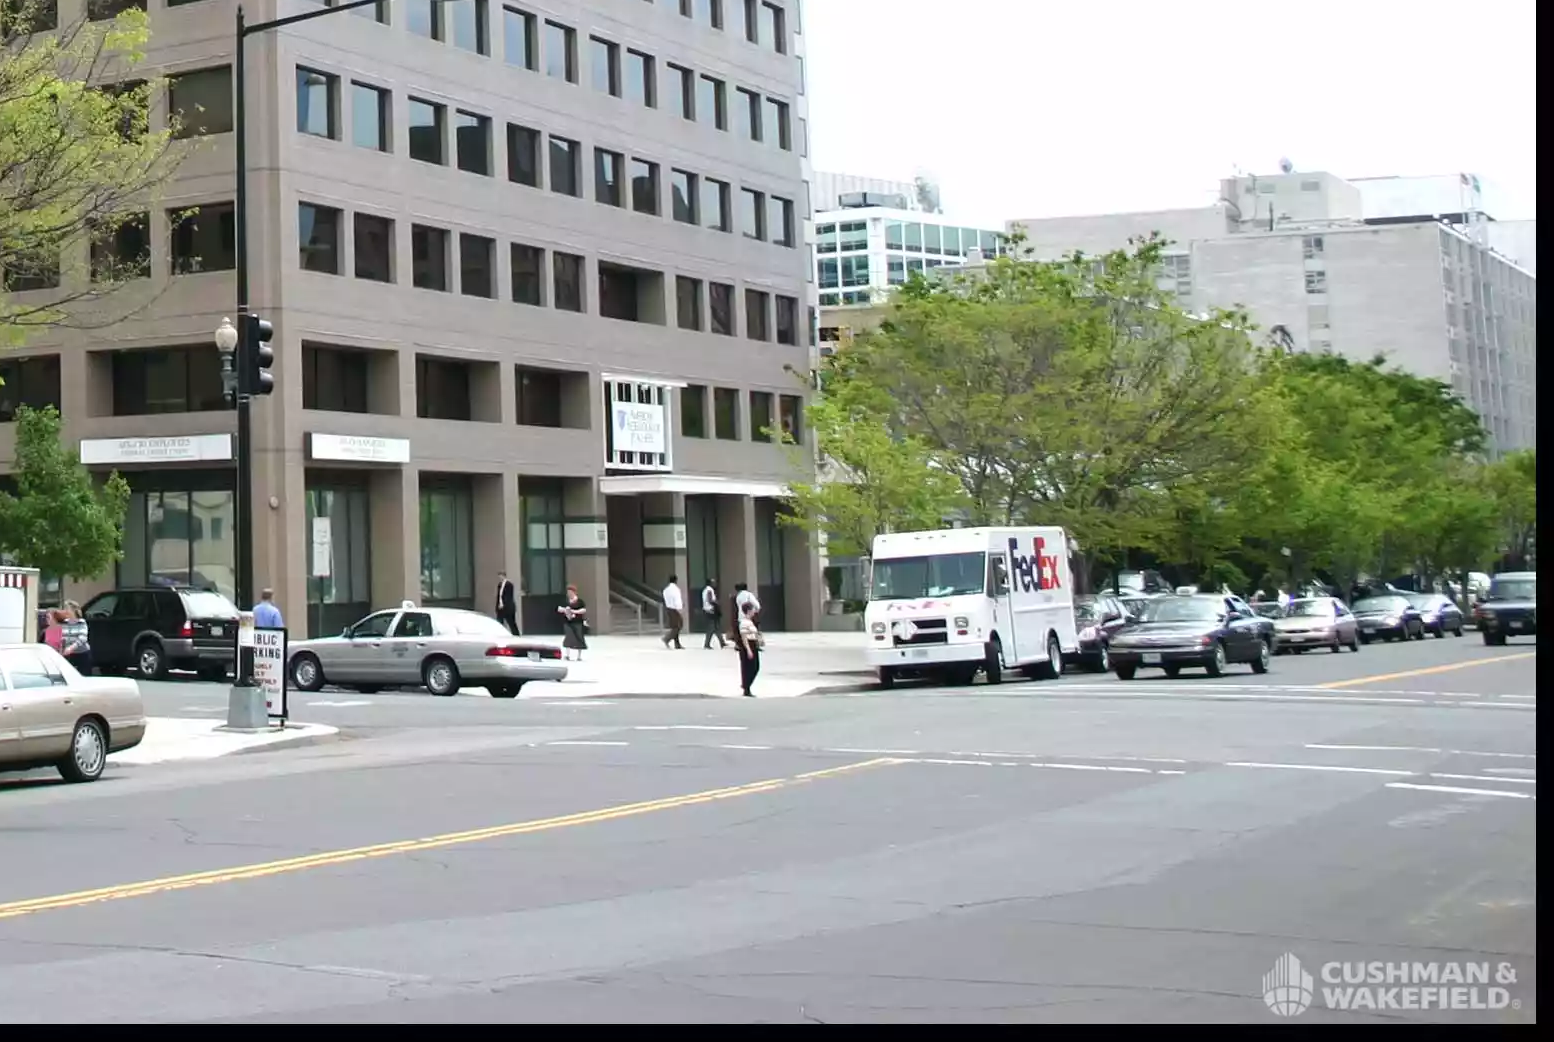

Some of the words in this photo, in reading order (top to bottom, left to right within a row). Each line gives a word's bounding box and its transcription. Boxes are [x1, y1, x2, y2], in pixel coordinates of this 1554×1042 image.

[1008, 537, 1061, 592] FedEx
[254, 633, 278, 646] BLIC
[253, 647, 281, 659] RKING
